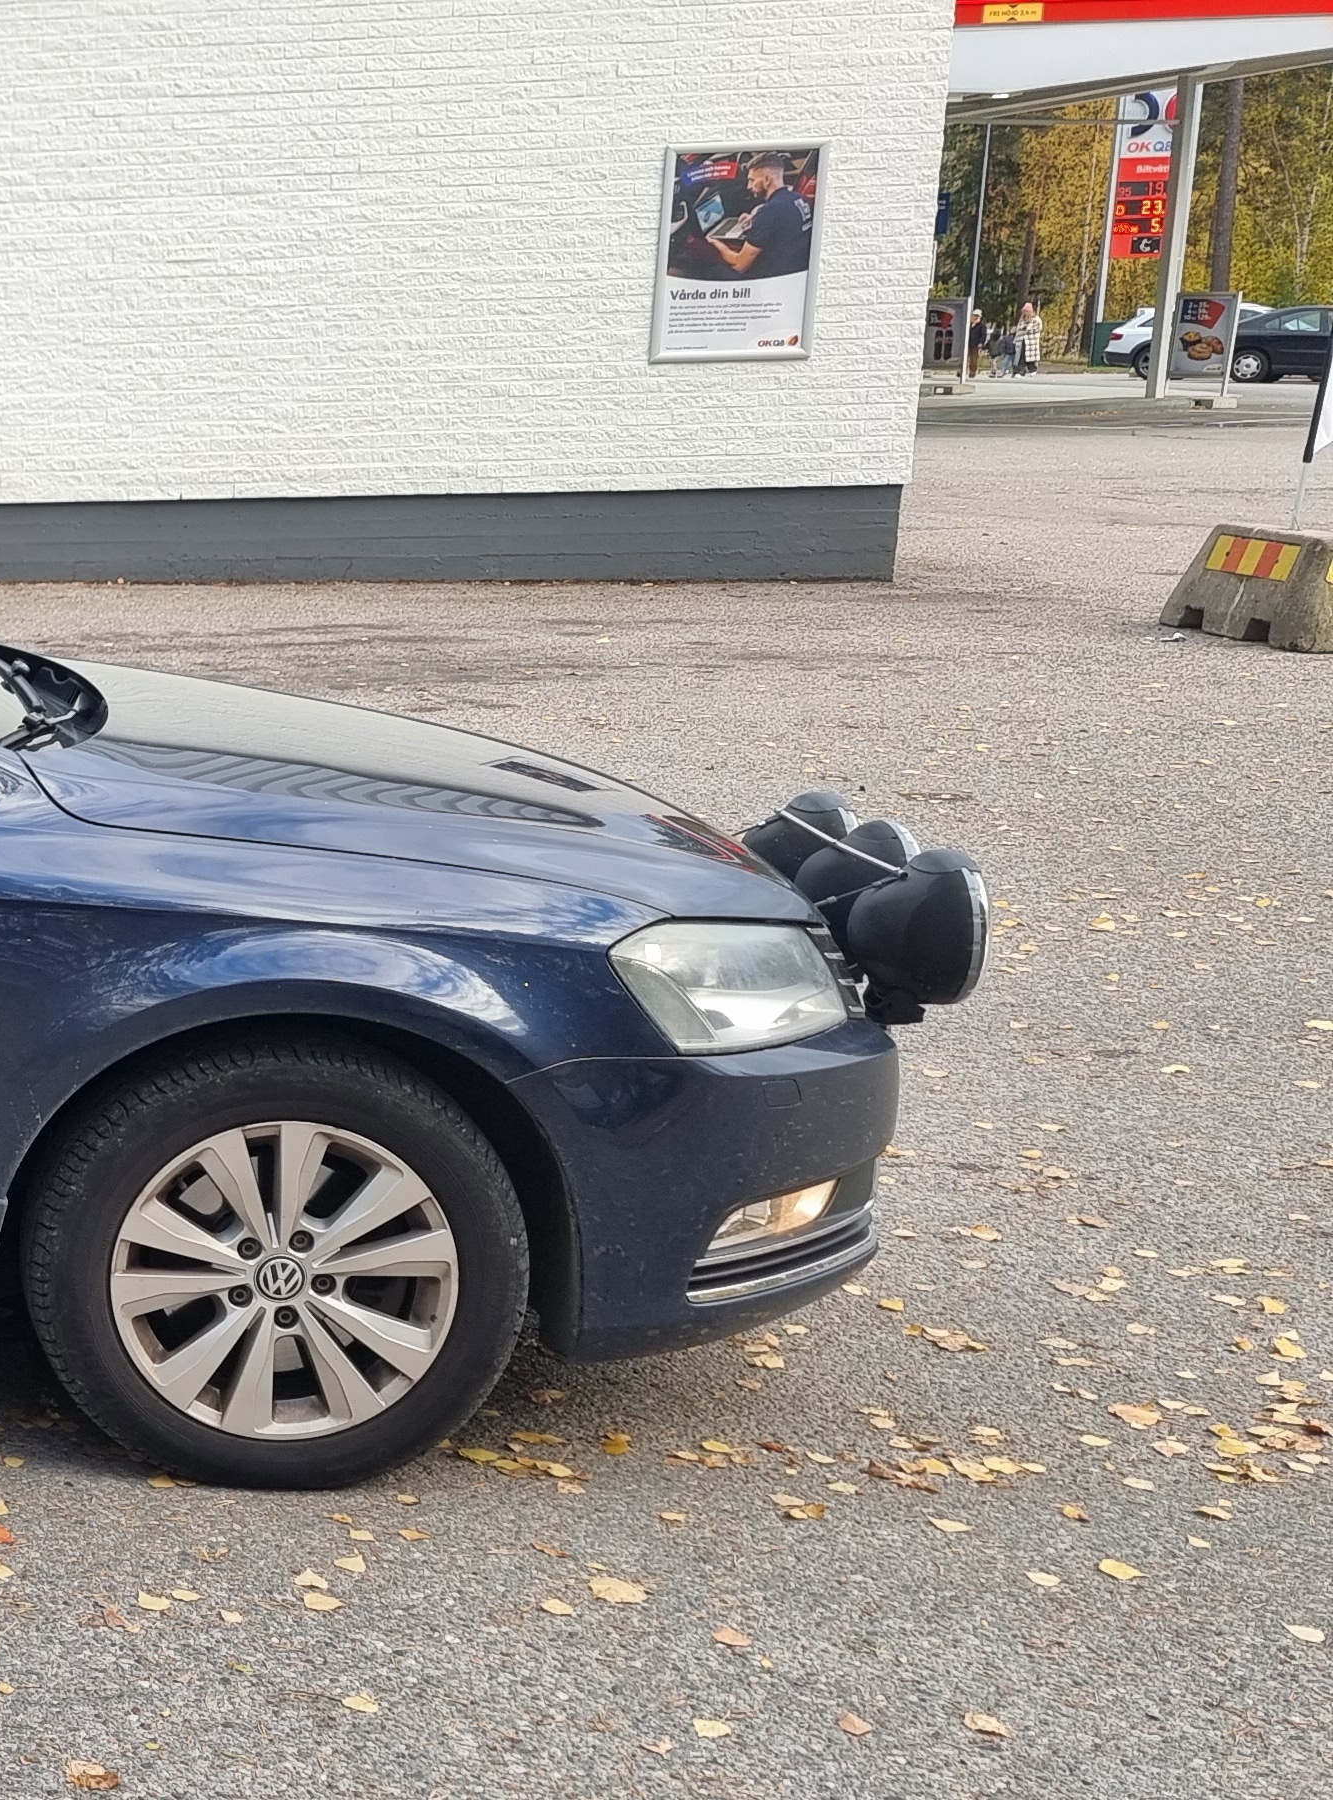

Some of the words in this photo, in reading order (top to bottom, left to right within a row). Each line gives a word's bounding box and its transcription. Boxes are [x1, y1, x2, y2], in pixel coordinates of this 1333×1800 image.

[1117, 186, 1132, 197] 95
[1115, 204, 1126, 216] D
[670, 288, 707, 300] Vårda
[710, 288, 729, 299] din
